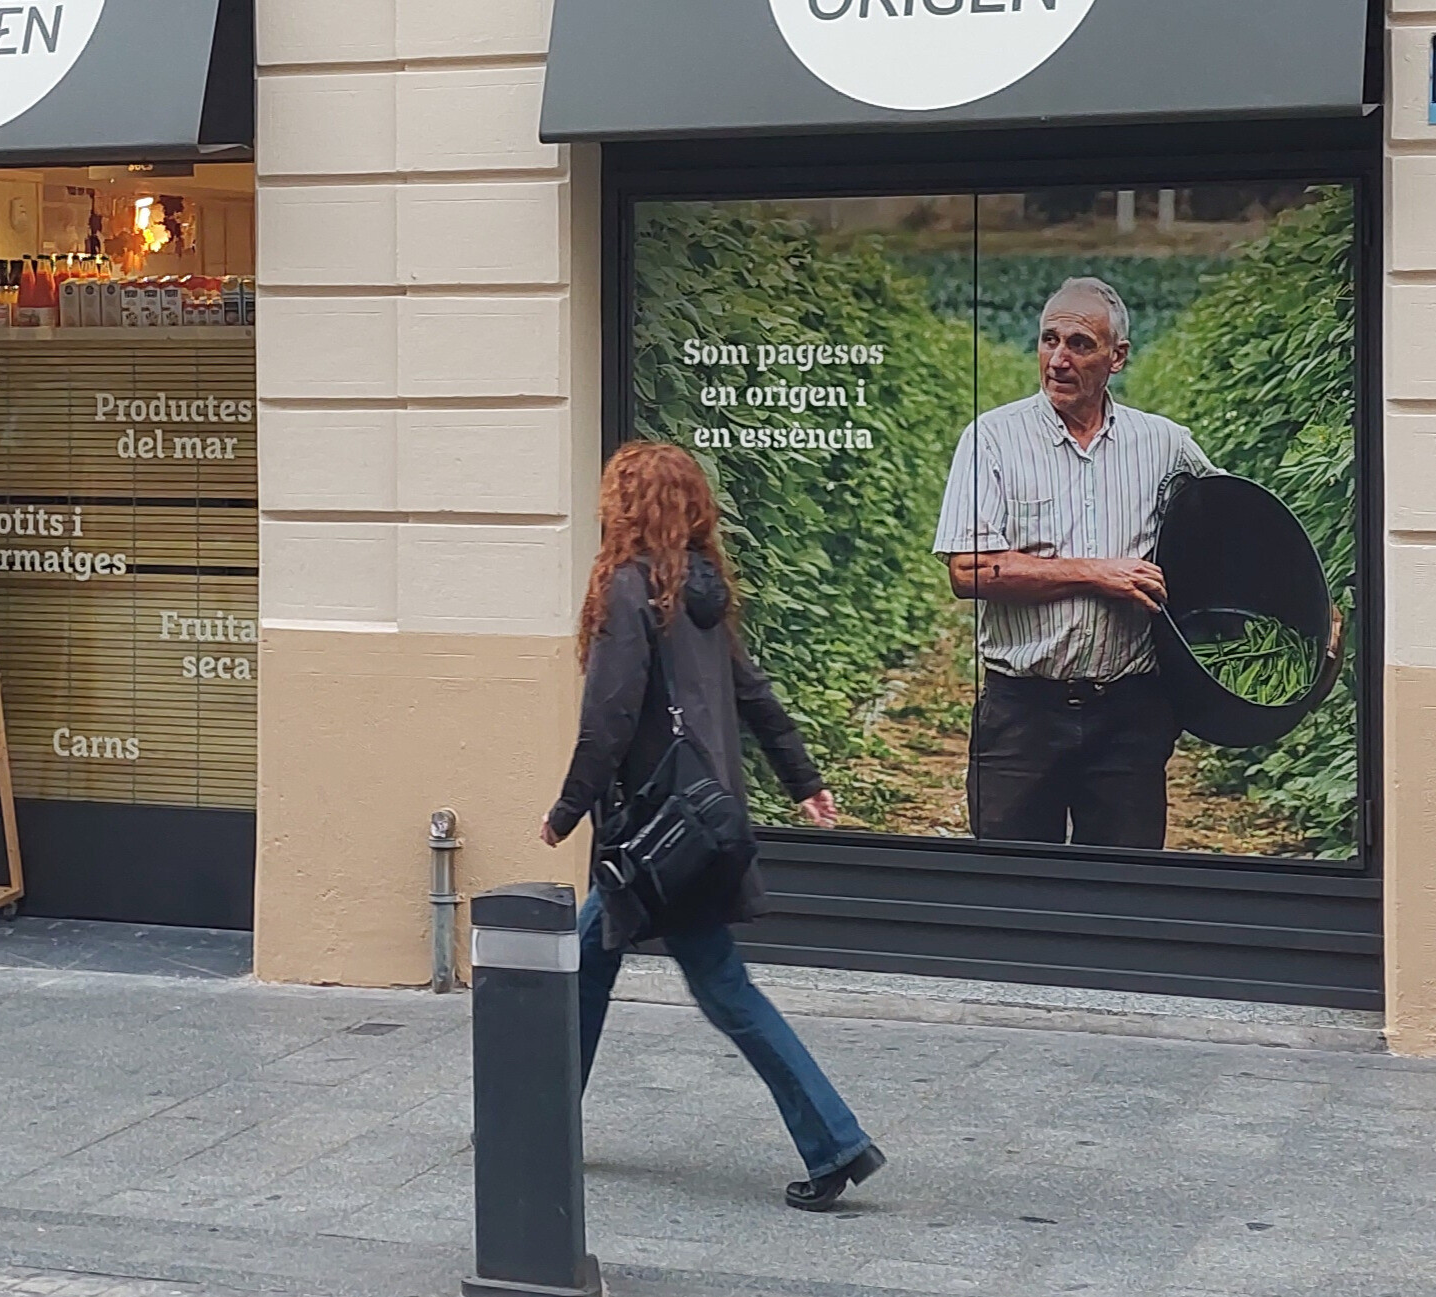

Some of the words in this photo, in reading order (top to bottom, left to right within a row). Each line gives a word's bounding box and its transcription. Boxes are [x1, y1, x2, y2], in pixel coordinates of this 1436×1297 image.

[682, 338, 749, 366] Som
[757, 340, 885, 372] pagesos
[95, 393, 253, 423] Productes
[700, 386, 739, 408] en
[745, 378, 848, 413] origen
[856, 379, 867, 408] i
[117, 429, 164, 459] del
[173, 436, 238, 460] mar
[693, 427, 732, 450] en
[739, 421, 874, 451] essència
[72, 506, 84, 537] i
[159, 610, 258, 642] Fruita
[183, 655, 251, 680] seca
[52, 727, 140, 760] Carns
